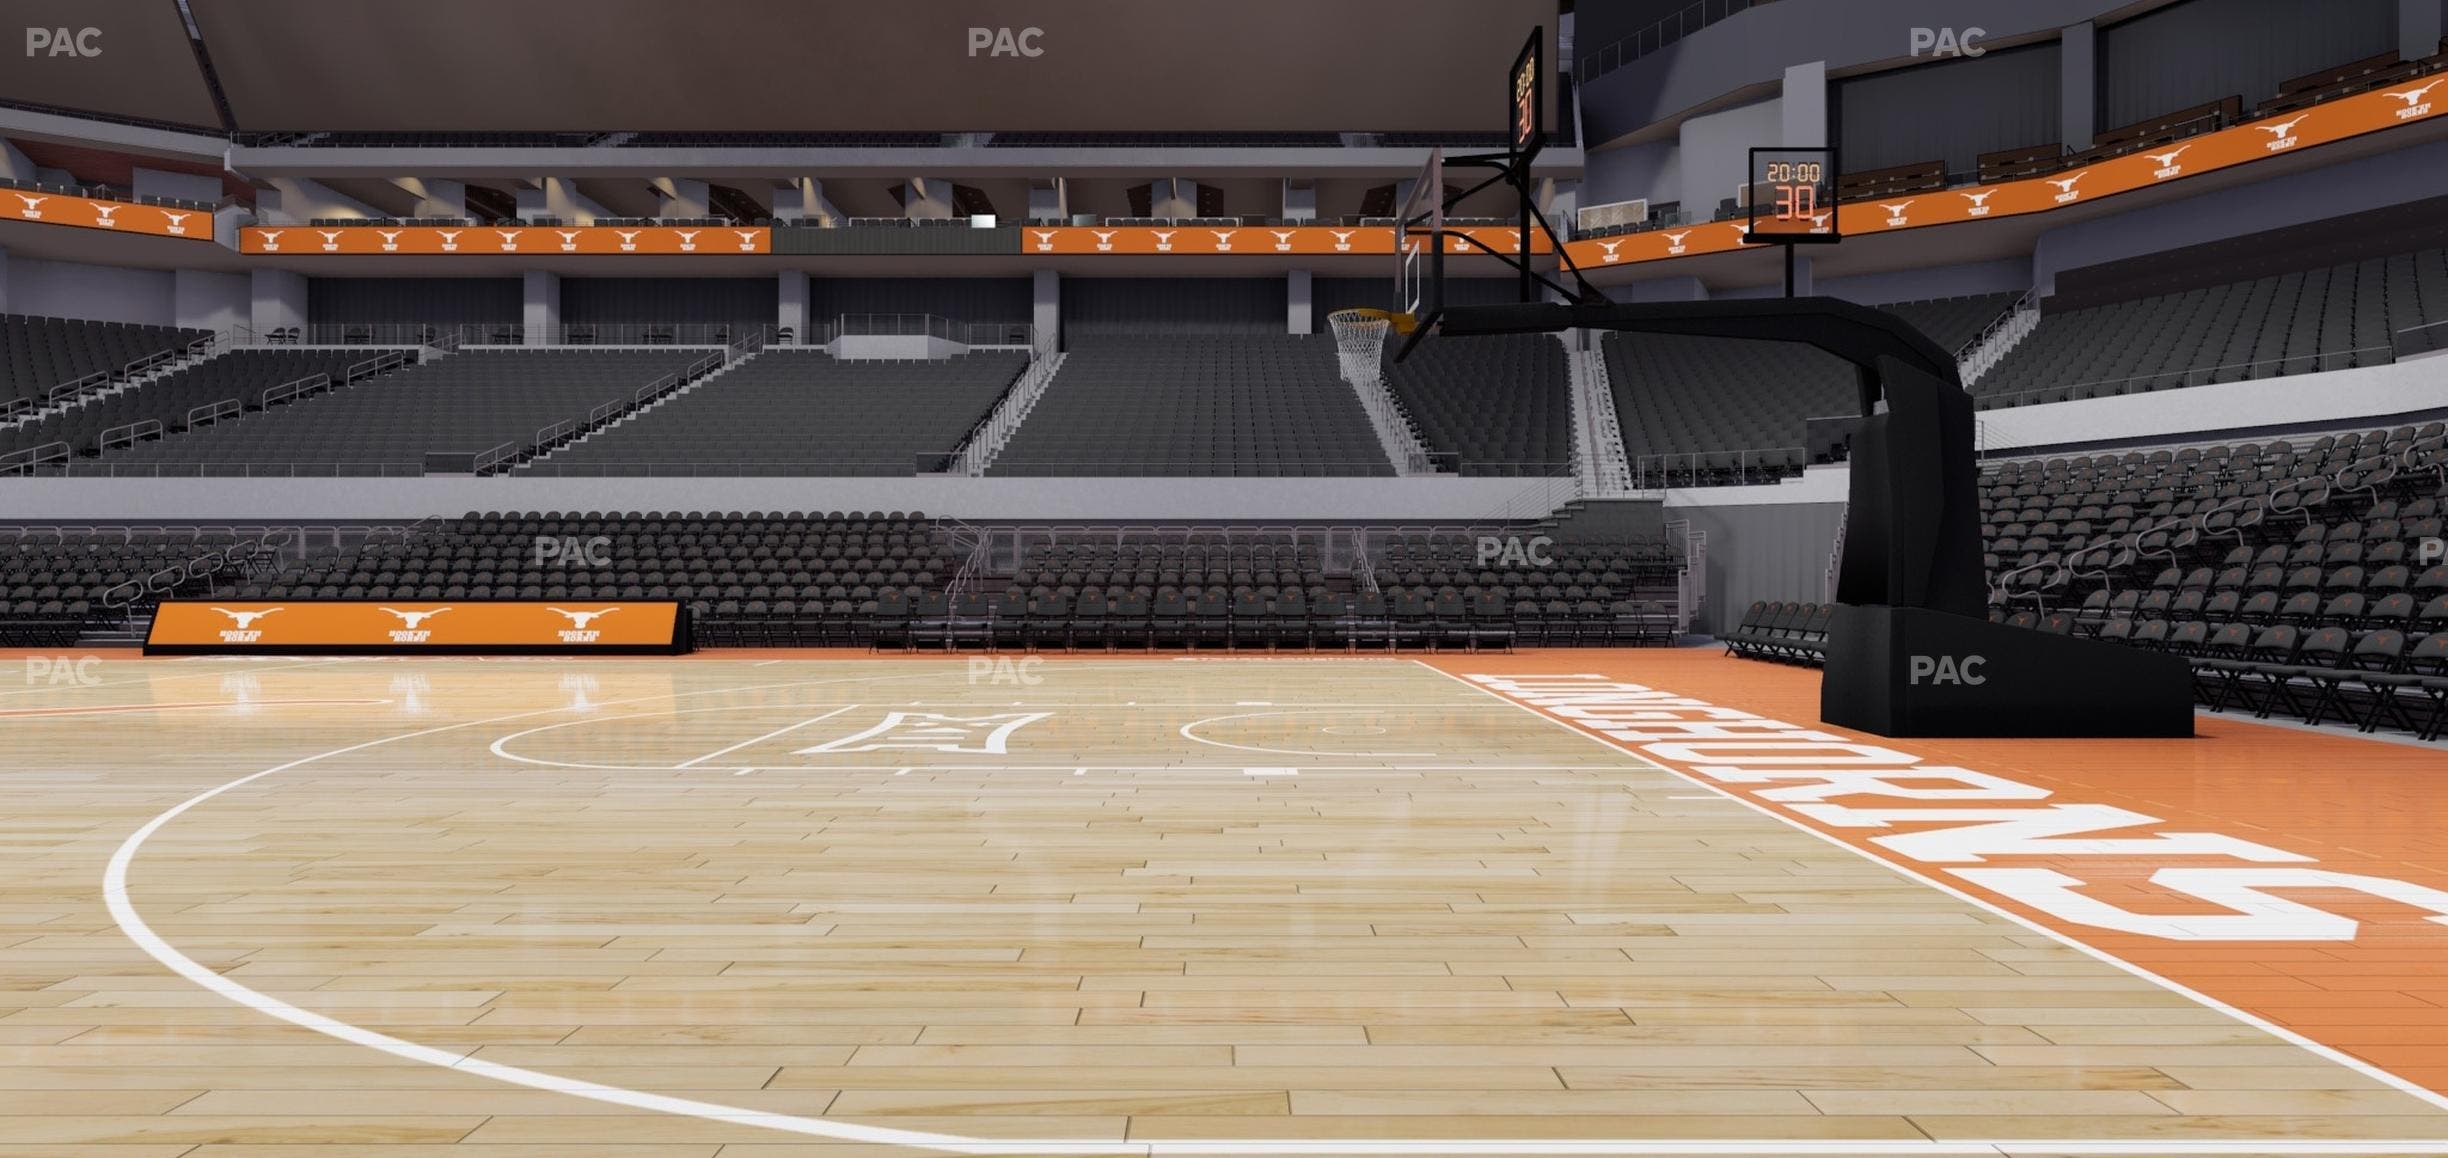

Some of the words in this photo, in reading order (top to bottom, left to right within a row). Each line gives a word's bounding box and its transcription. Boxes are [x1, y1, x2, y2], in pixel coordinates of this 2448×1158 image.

[1767, 163, 1820, 182] 20:00
[1775, 185, 1814, 219] 30
[1461, 673, 2448, 941] LONGHORNS
